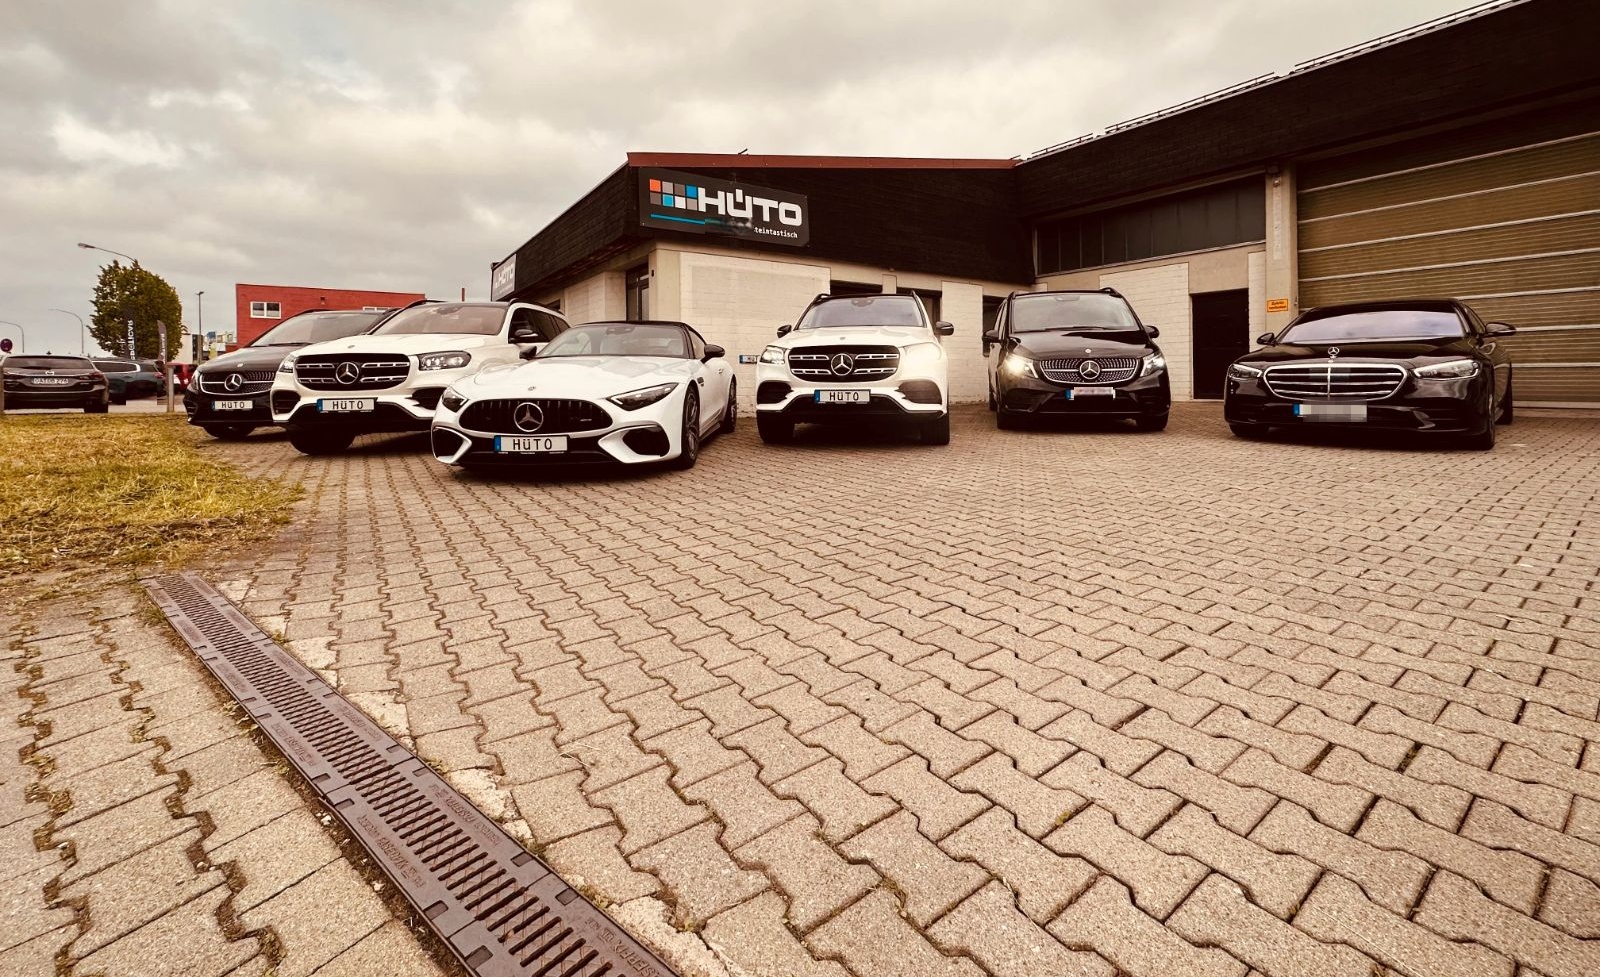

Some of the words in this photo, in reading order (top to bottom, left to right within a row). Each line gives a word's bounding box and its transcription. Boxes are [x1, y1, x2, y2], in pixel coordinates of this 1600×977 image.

[830, 391, 859, 401] HÜTO
[221, 401, 245, 409] HÜTO
[332, 400, 364, 410] HÜTO
[512, 437, 553, 451] HÜTO
